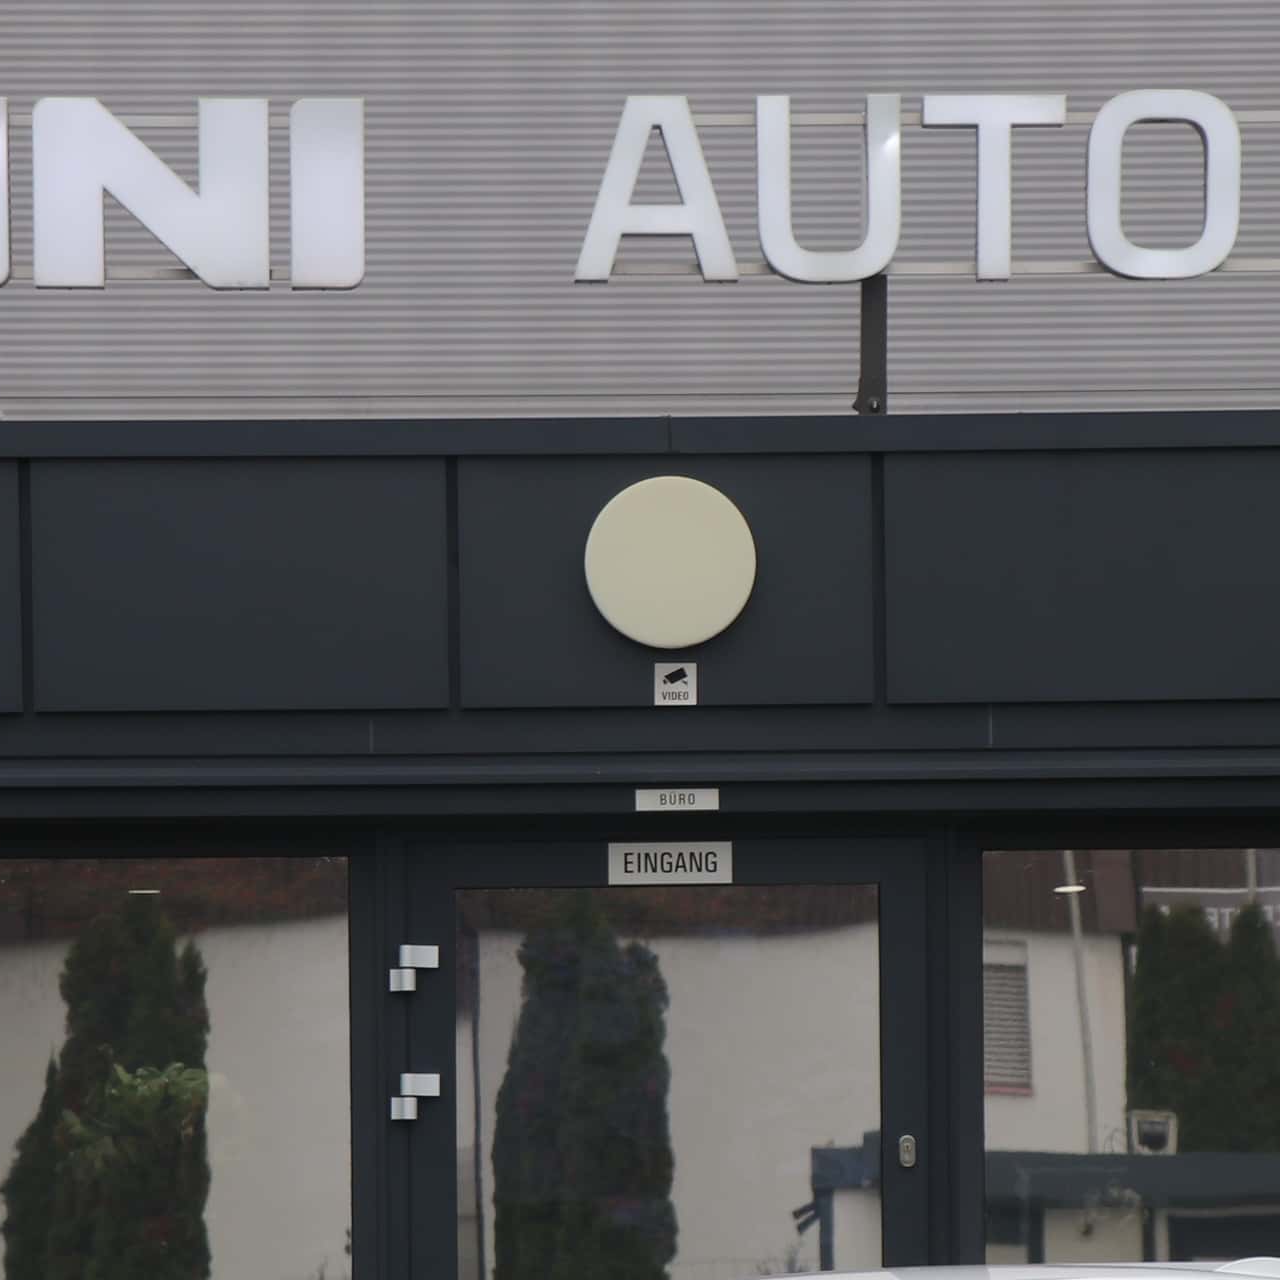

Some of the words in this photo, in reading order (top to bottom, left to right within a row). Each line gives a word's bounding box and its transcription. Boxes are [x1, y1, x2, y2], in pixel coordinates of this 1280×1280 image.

[574, 88, 1242, 284] AUTO
[661, 690, 690, 701] VIDEO
[659, 791, 697, 806] BÜRO
[623, 851, 719, 874] EINGANG
